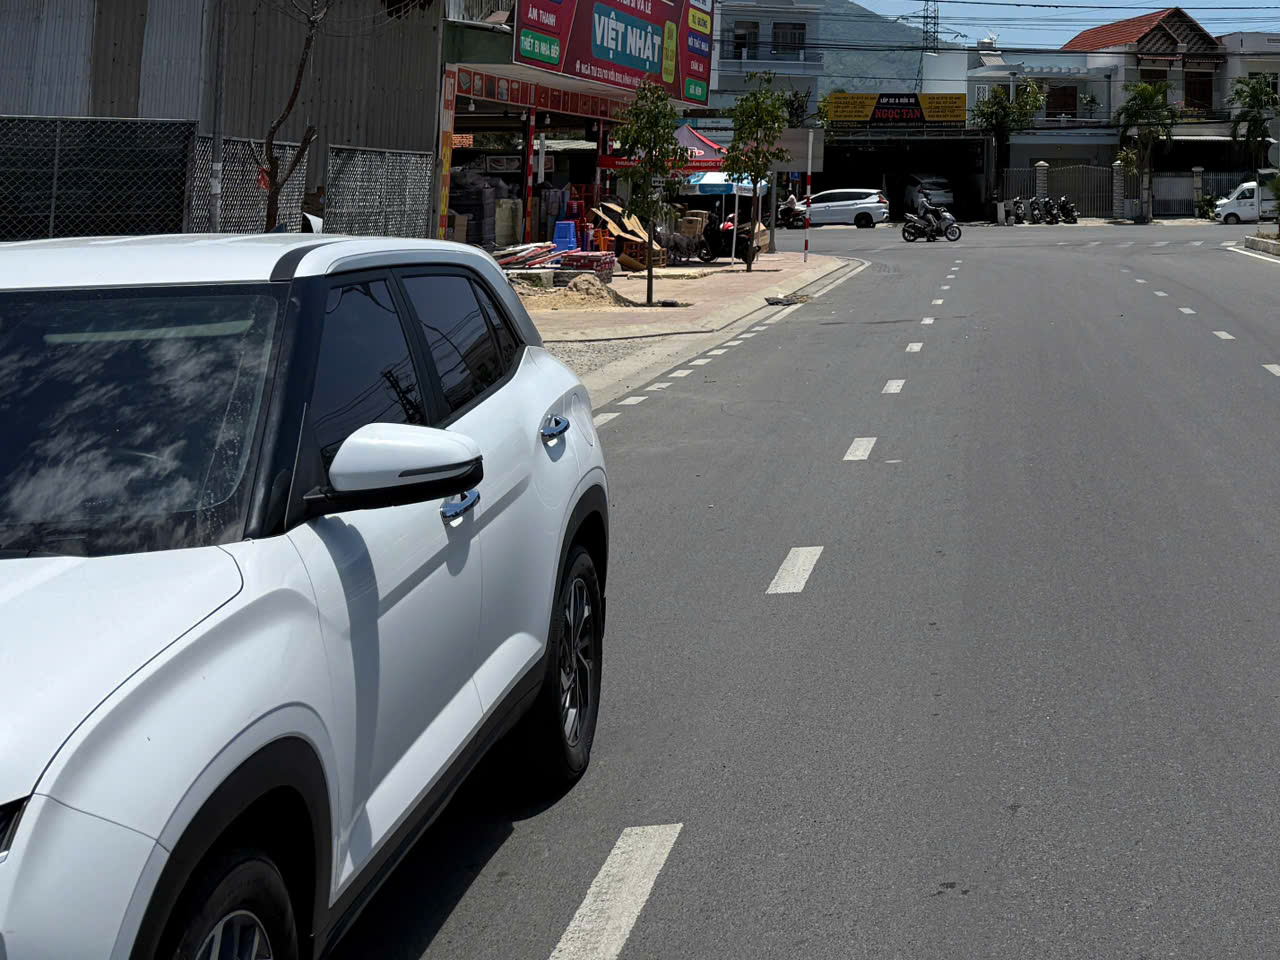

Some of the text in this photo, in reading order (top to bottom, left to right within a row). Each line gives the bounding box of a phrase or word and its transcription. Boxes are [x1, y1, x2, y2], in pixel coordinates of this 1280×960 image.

[520, 34, 534, 51] THIẾT
[594, 11, 662, 70] VIỆT NHẬT
[875, 108, 900, 121] NGỌC
